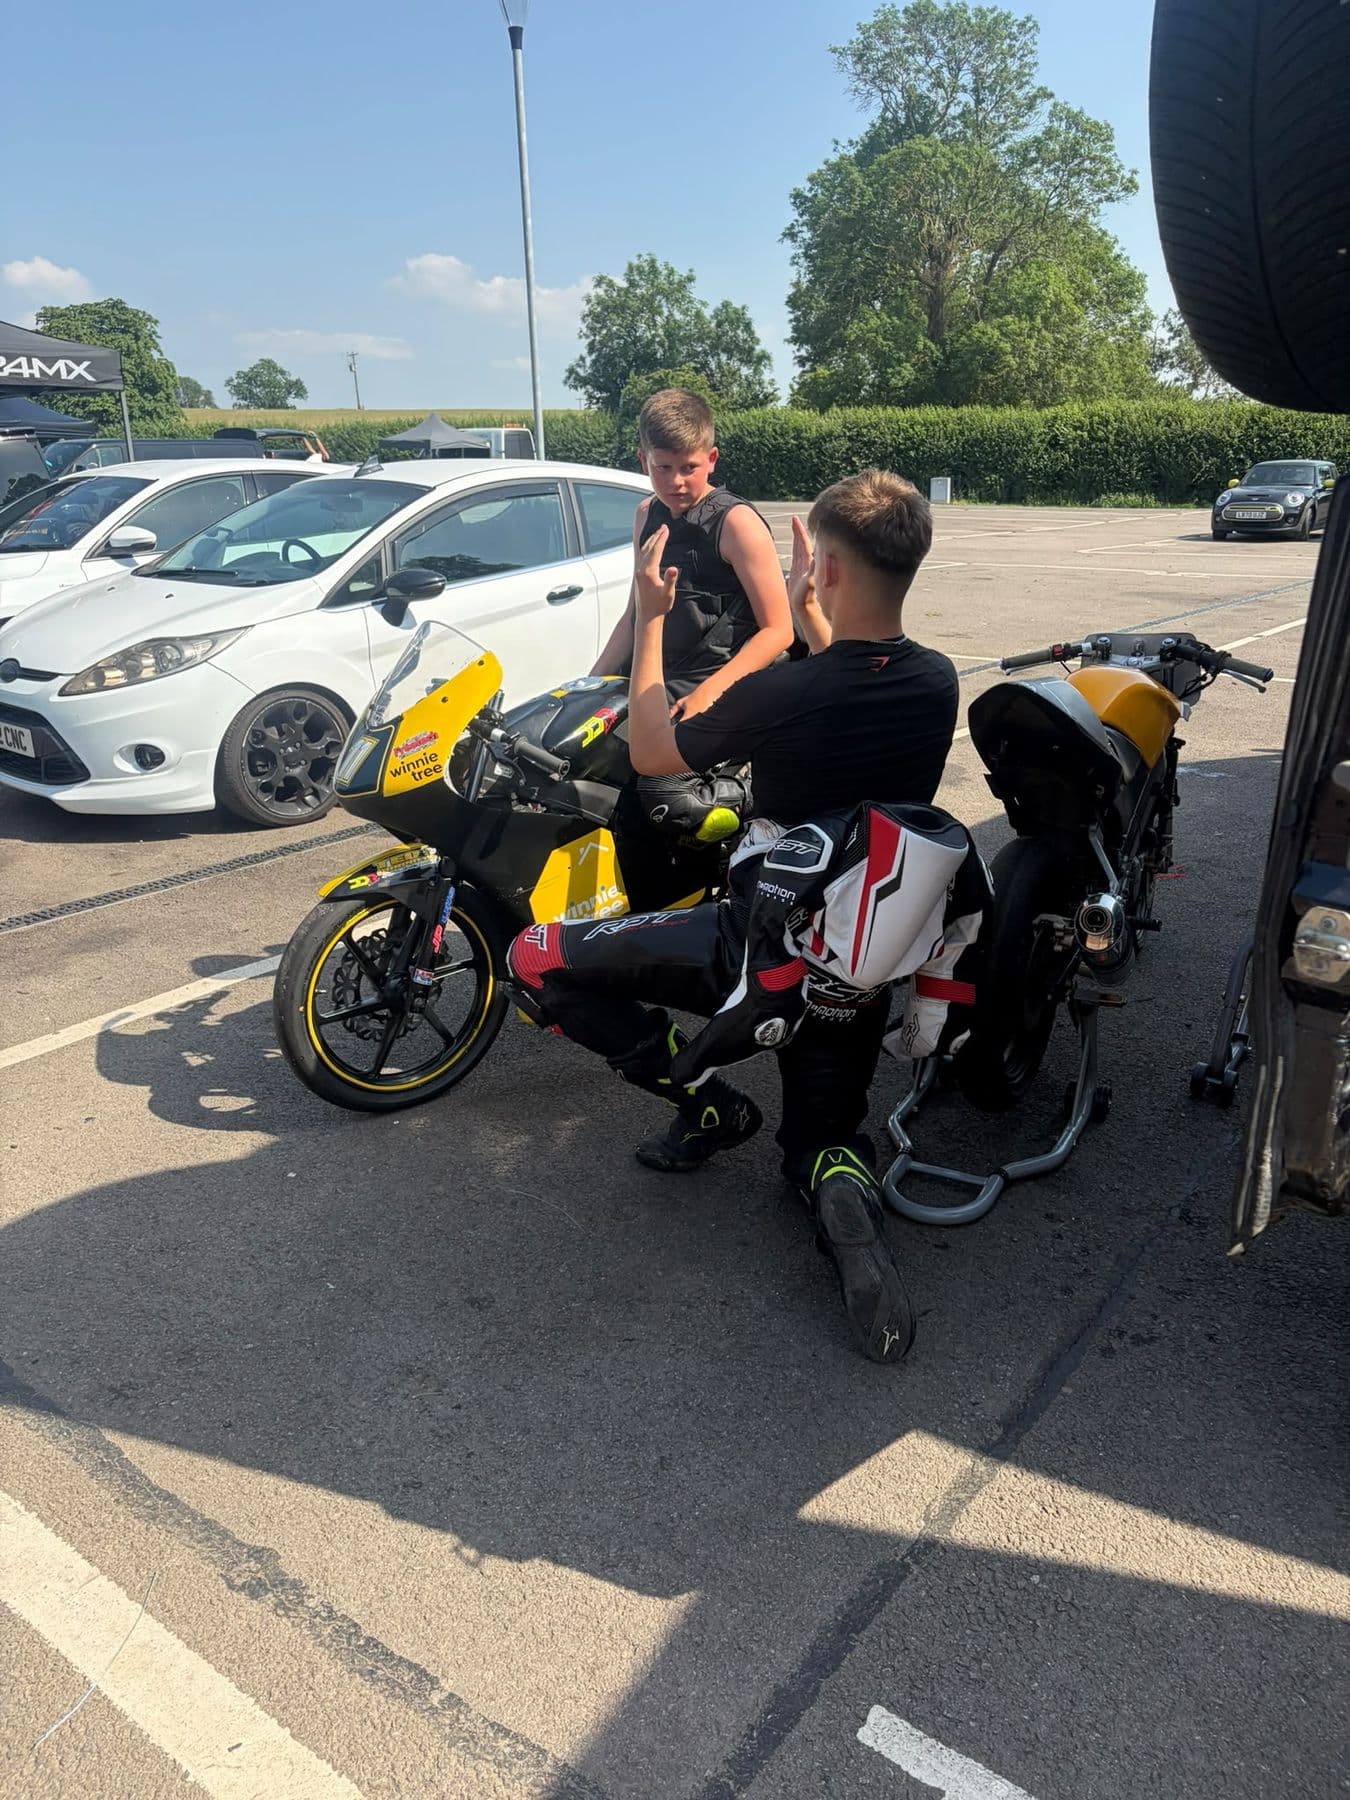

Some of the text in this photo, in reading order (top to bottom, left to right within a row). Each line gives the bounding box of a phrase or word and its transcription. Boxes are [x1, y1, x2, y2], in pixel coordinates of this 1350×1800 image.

[4, 726, 27, 751] CNC
[390, 752, 438, 778] winnie
[411, 764, 443, 781] tree
